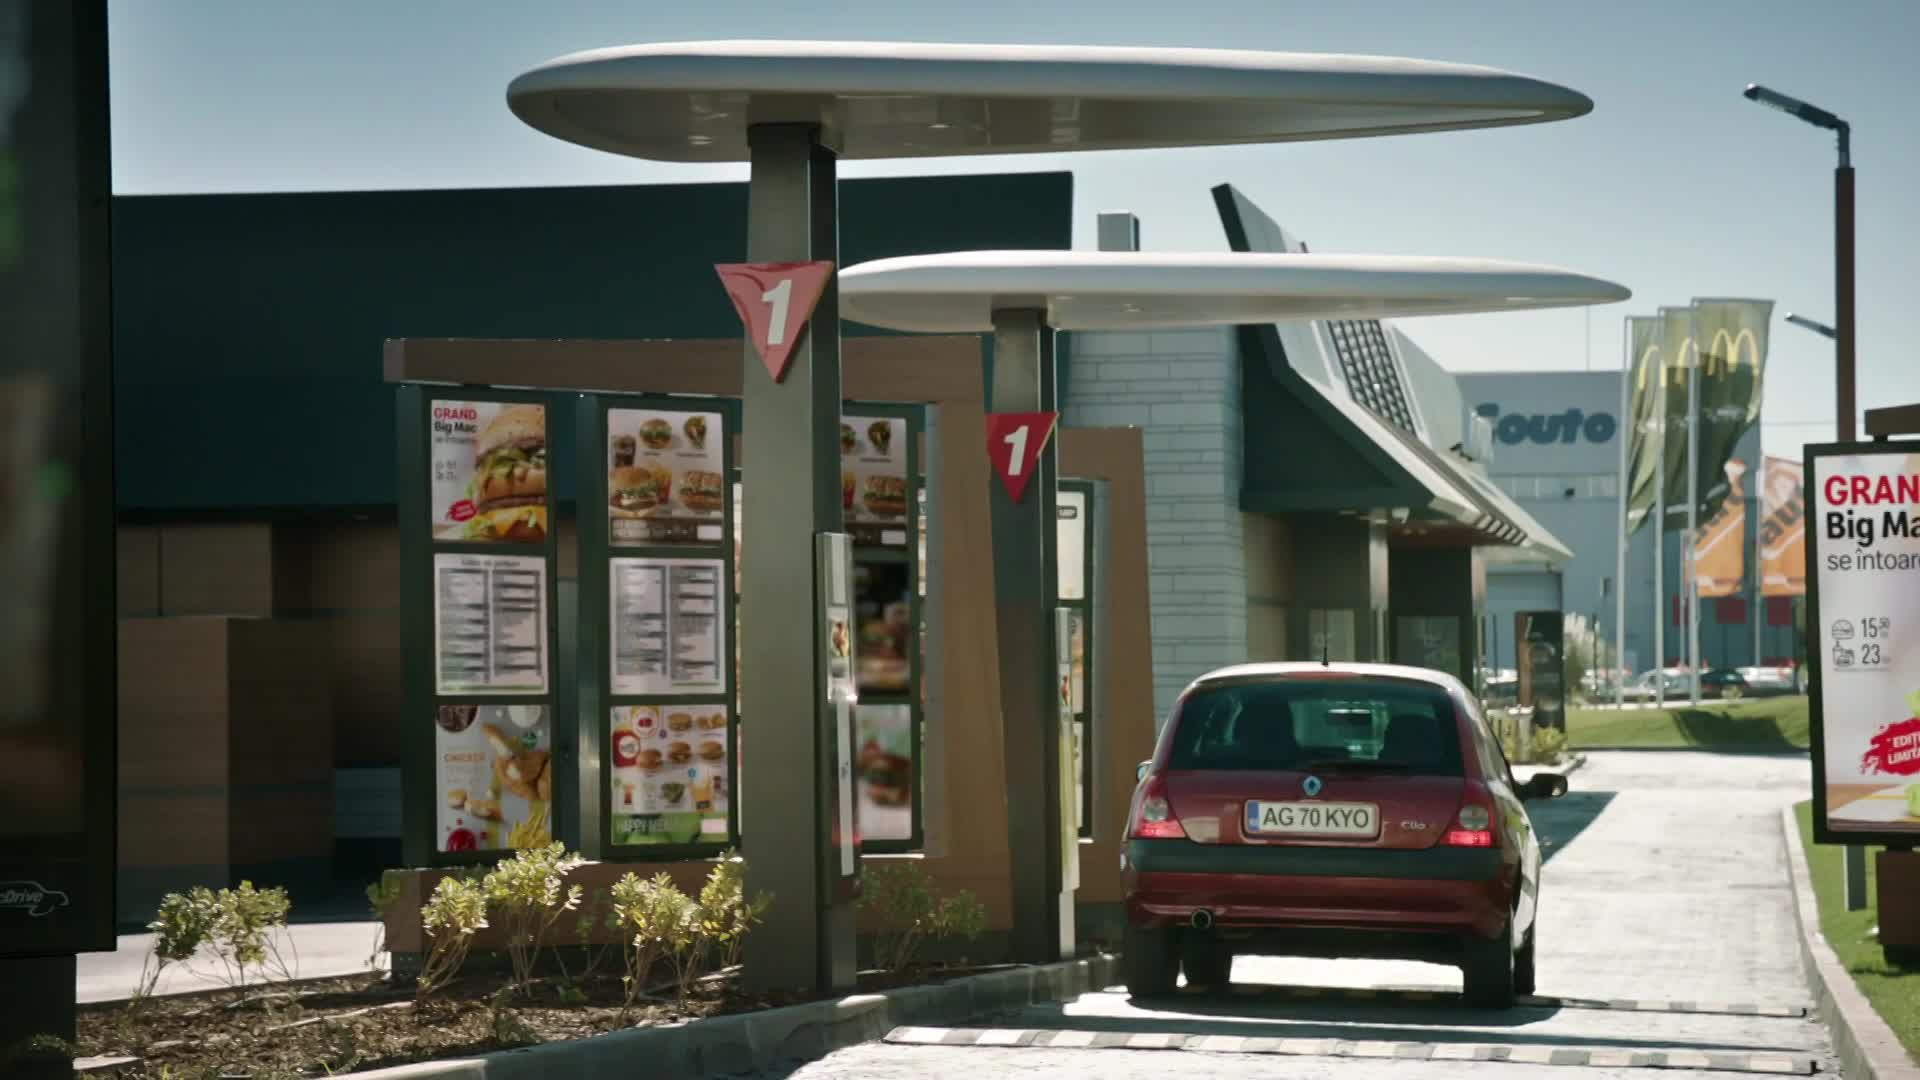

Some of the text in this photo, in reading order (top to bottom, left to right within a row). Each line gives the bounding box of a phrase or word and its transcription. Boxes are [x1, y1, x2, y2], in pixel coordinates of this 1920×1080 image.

[762, 279, 793, 346] 1
[434, 407, 478, 421] GRAND
[1004, 425, 1030, 477] 1
[1824, 474, 1920, 506] GRAN
[1826, 509, 1920, 548] Big Ma
[1826, 553, 1852, 572] se
[1861, 643, 1881, 665] 23
[1263, 807, 1370, 828] AG 70 KYO
